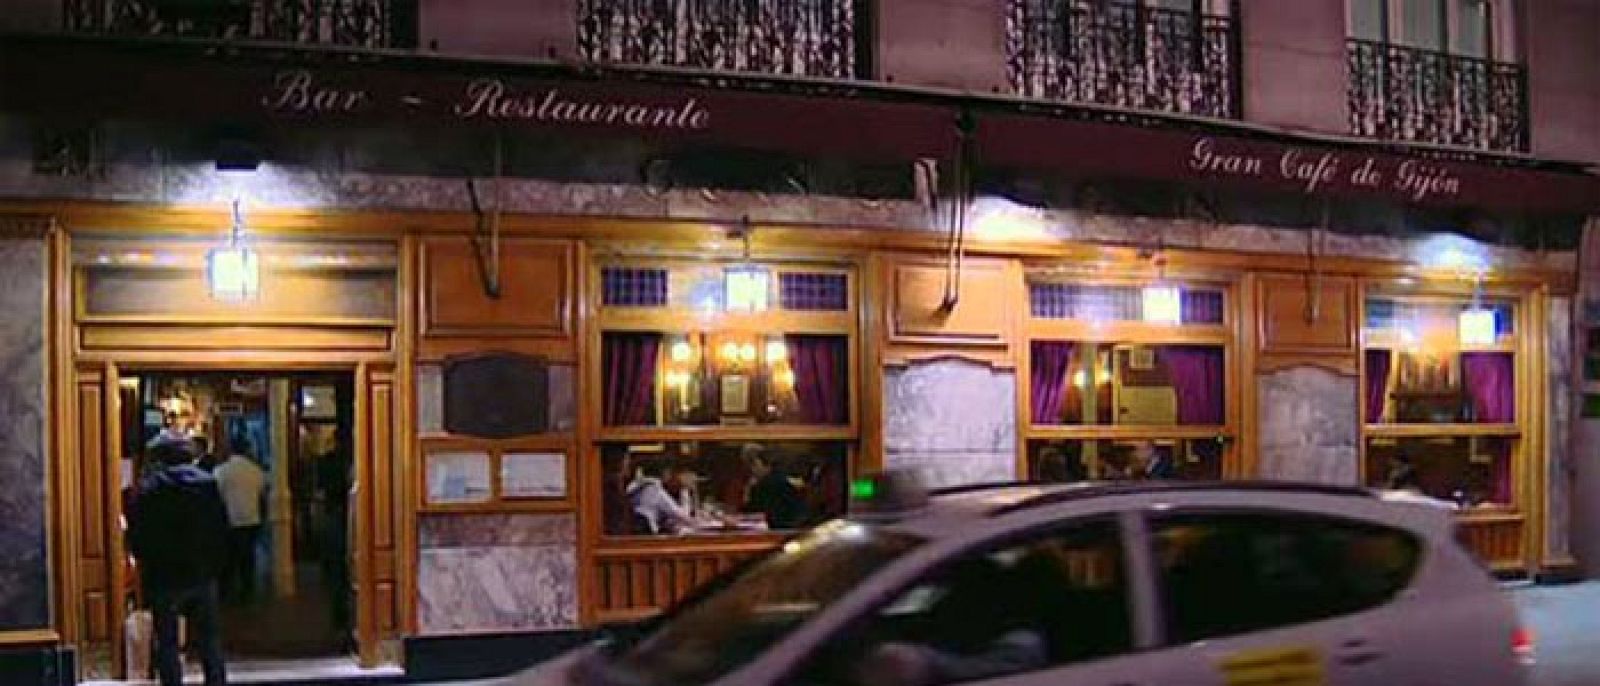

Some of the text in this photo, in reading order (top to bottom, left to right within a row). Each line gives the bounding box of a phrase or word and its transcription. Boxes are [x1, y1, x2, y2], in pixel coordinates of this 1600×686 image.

[262, 70, 367, 112] Bar
[454, 78, 709, 130] Restaurante
[1189, 136, 1460, 200] Gran Café de Gijón
